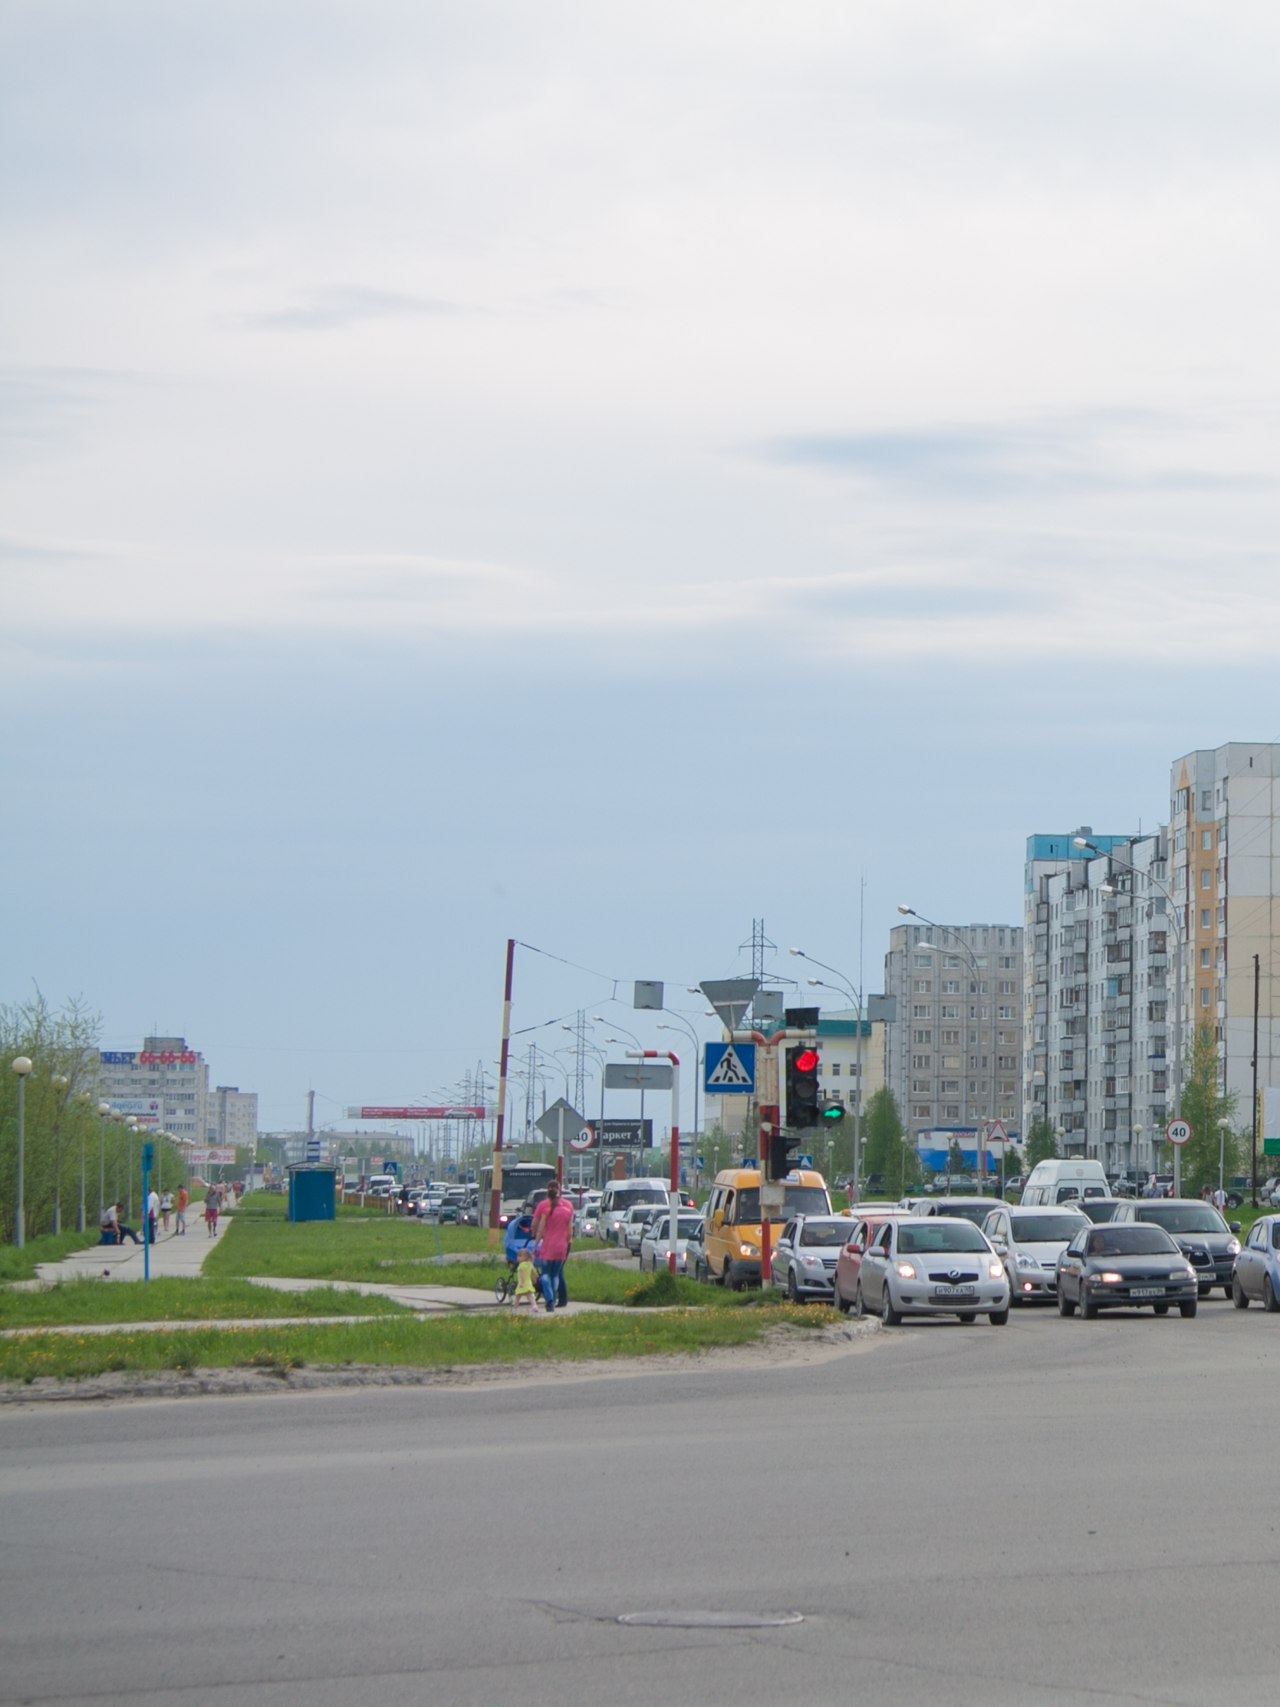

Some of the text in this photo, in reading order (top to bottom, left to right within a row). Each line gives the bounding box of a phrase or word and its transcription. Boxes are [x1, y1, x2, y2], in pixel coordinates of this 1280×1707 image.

[101, 1050, 196, 1066] МЬЕР 66-66-66
[1171, 1127, 1187, 1137] 40
